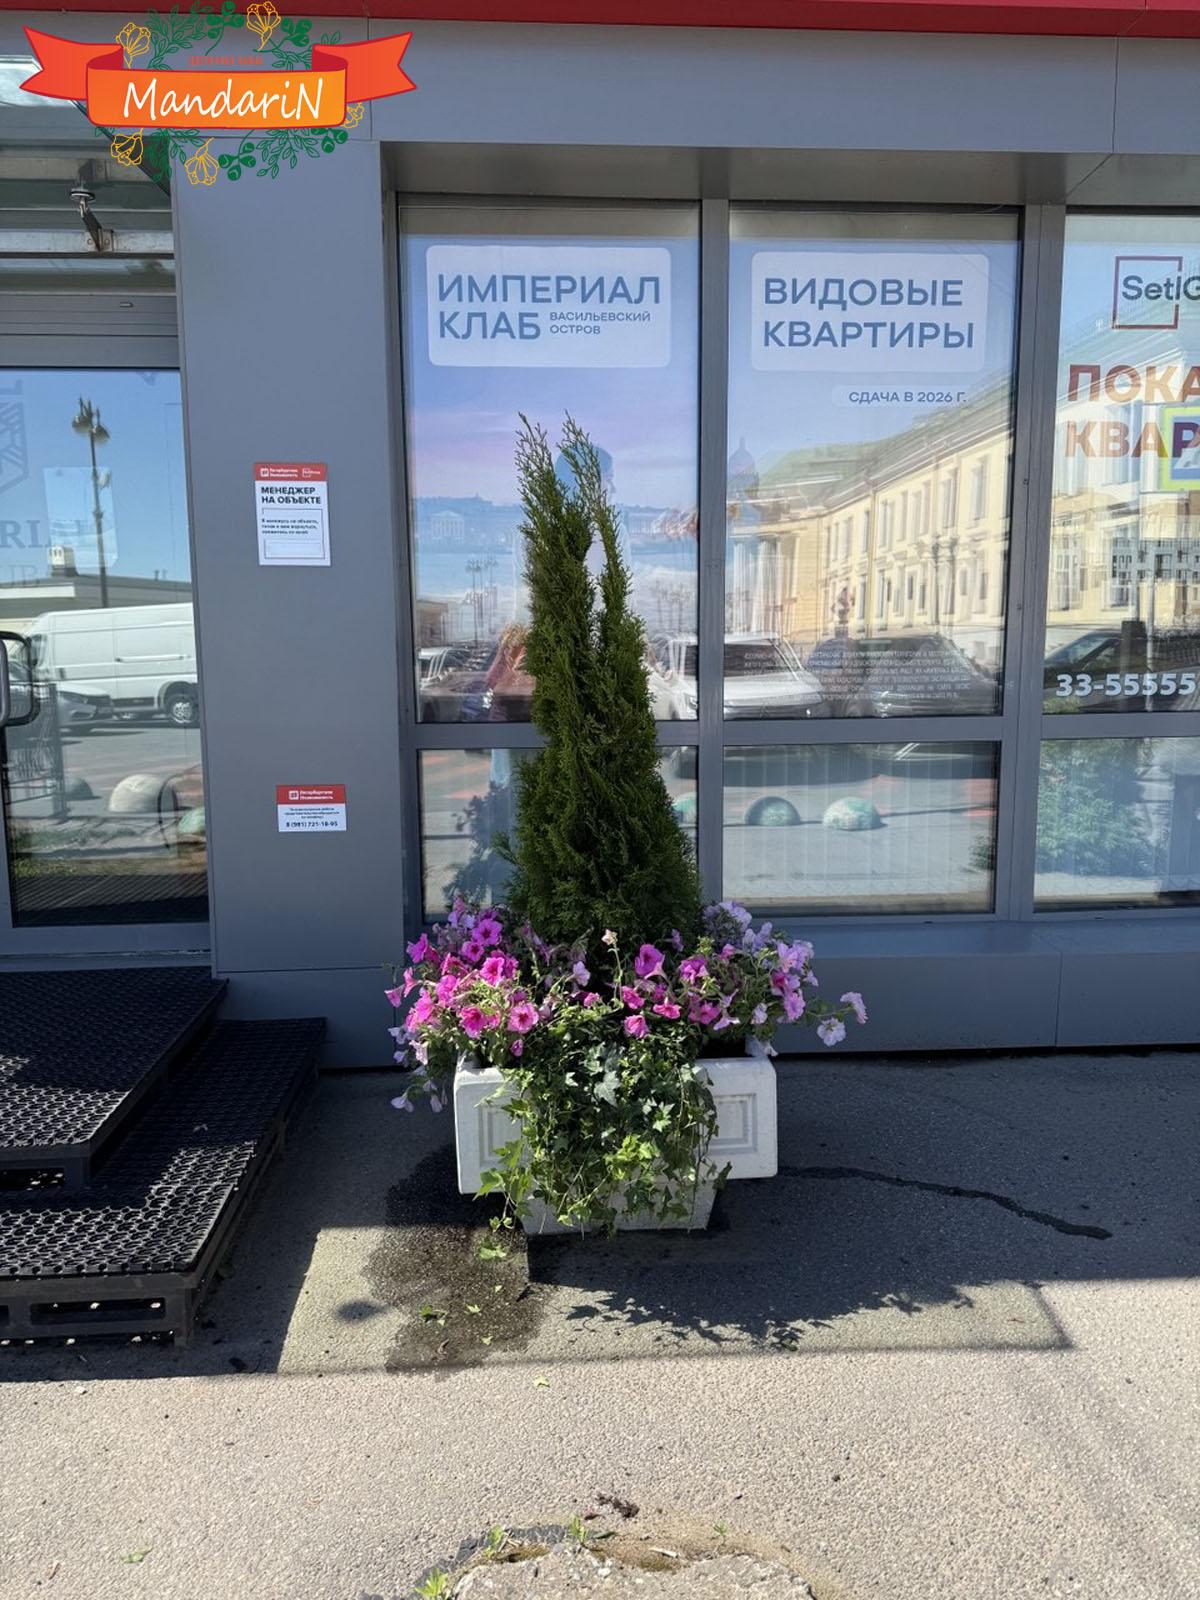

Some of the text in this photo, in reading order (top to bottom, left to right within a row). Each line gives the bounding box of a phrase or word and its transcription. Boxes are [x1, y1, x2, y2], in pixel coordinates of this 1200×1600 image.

[438, 273, 661, 304] ИМПЕРИАЛ
[764, 277, 964, 311] ВИДОВЫЕ
[439, 310, 541, 340] КЛАБ
[549, 310, 651, 322] ВАСИЛЬЕВСКИЙ
[549, 324, 601, 335] ОСТРОВ
[763, 320, 974, 349] КВАРТИРЫ
[848, 391, 900, 404] СДАЧА
[904, 391, 914, 402] В
[917, 391, 953, 403] 2026
[261, 487, 316, 495] МЕНЕДЖЕР
[261, 496, 321, 505] НА ОБЪЕКТЕ
[1055, 673, 1196, 697] 33-55555
